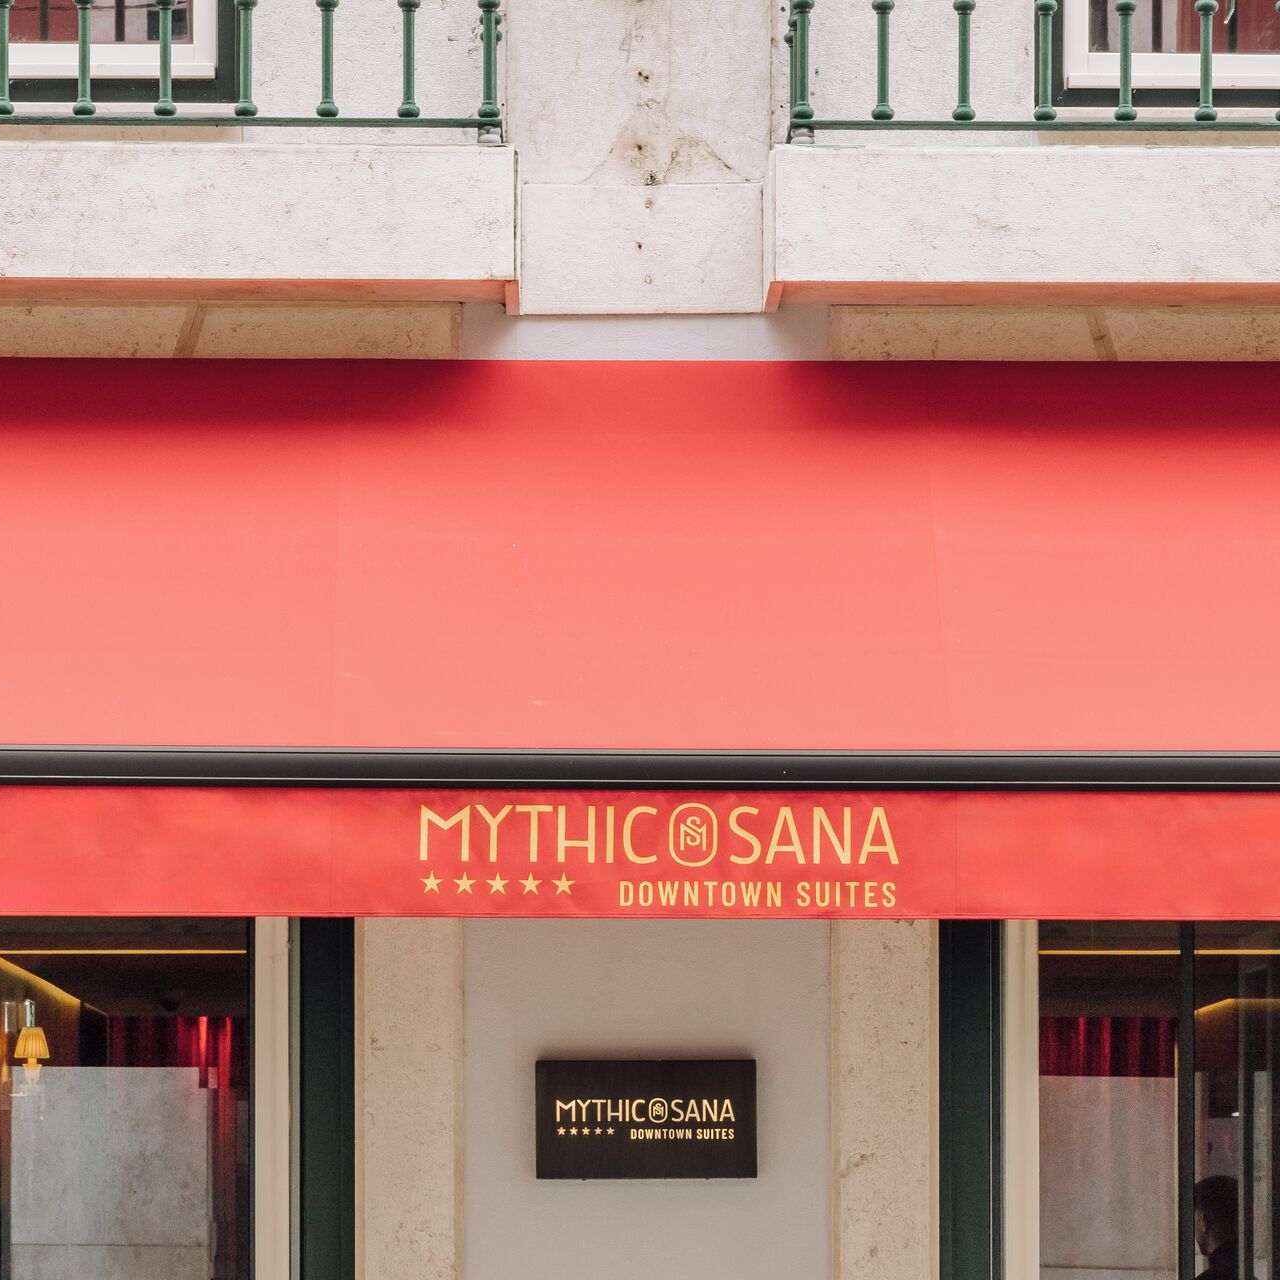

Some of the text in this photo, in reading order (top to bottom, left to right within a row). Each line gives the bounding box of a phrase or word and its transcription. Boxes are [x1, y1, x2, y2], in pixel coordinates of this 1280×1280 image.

[419, 804, 658, 865] MYTHIC
[728, 805, 900, 865] SANA
[619, 880, 897, 908] DOWNTOWN SUITES
[555, 1098, 646, 1122] MYTHIC
[670, 1098, 736, 1122] SANA
[630, 1127, 735, 1140] DOWNTOWN SUITES
